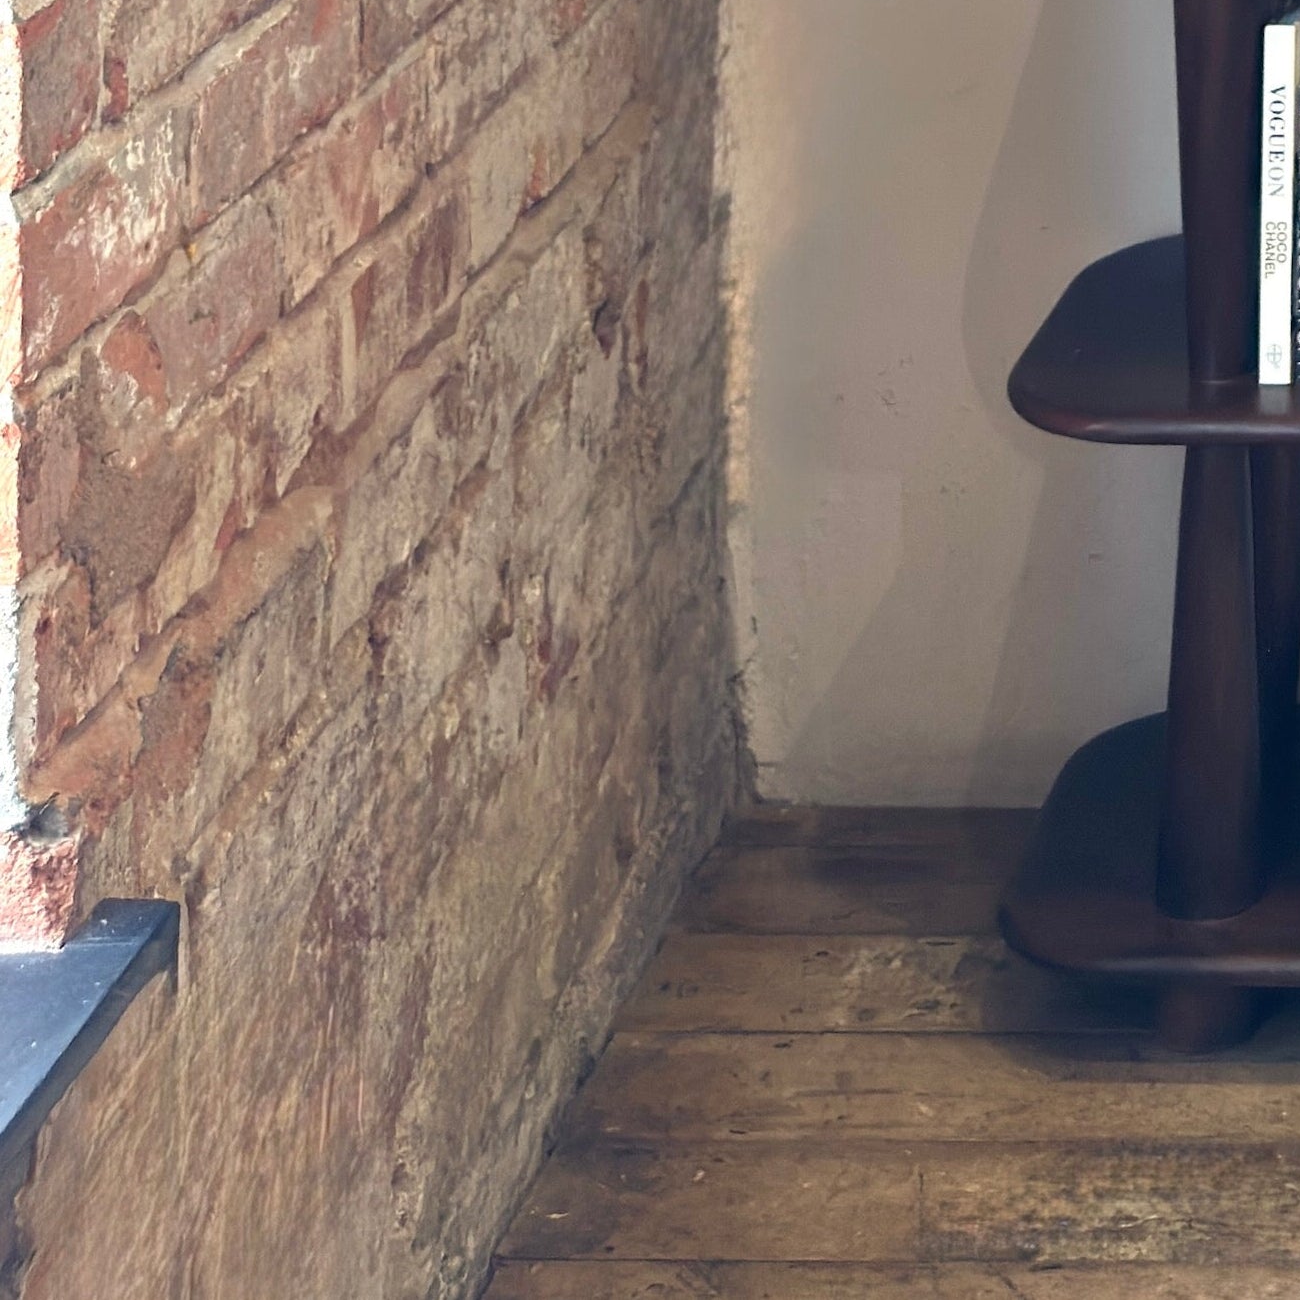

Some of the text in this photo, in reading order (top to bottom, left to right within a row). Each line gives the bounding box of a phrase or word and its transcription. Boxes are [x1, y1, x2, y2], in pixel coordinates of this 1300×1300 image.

[1268, 86, 1286, 197] VOGUE ON
[1264, 221, 1276, 279] CHANEL
[1276, 221, 1288, 264] COCO
